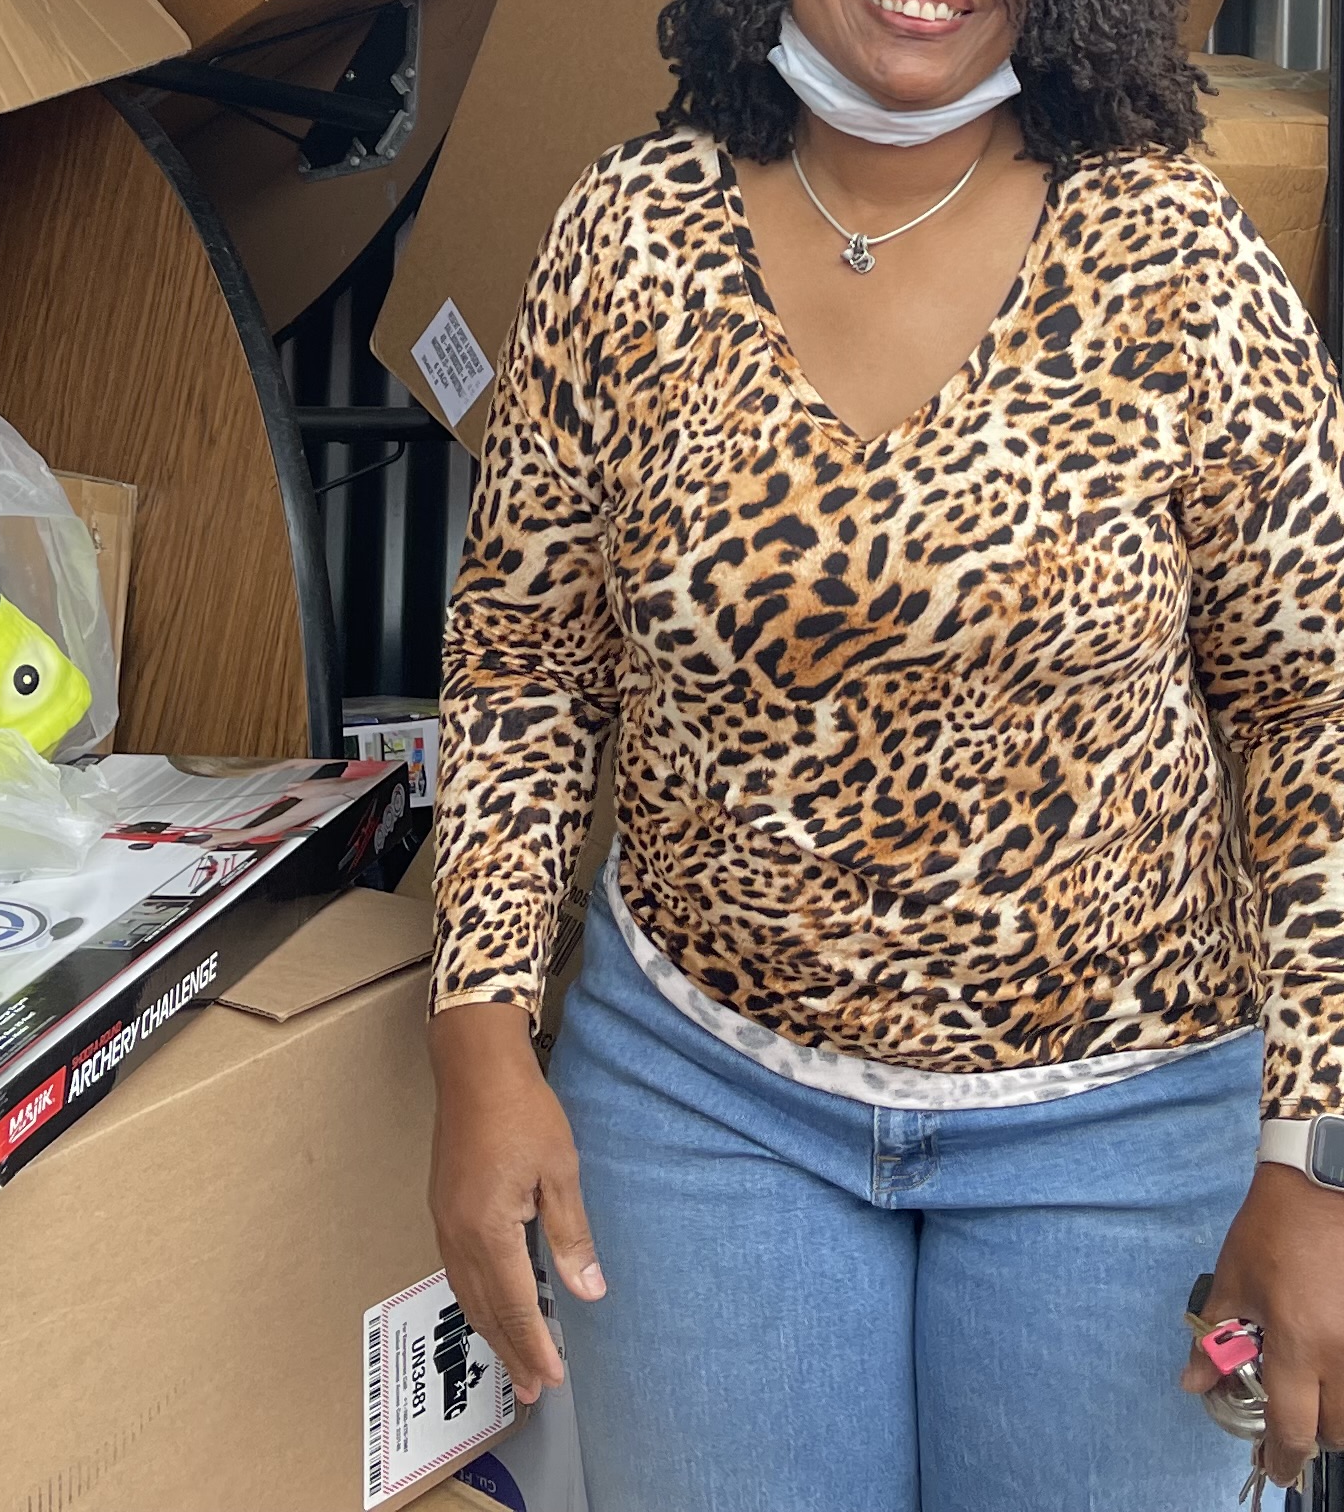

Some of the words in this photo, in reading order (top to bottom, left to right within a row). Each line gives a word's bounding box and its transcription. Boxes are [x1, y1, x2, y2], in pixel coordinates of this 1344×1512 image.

[67, 1017, 141, 1103] ARCHERY
[140, 951, 219, 1039] CHALLENGE
[411, 1335, 427, 1419] UN3481
